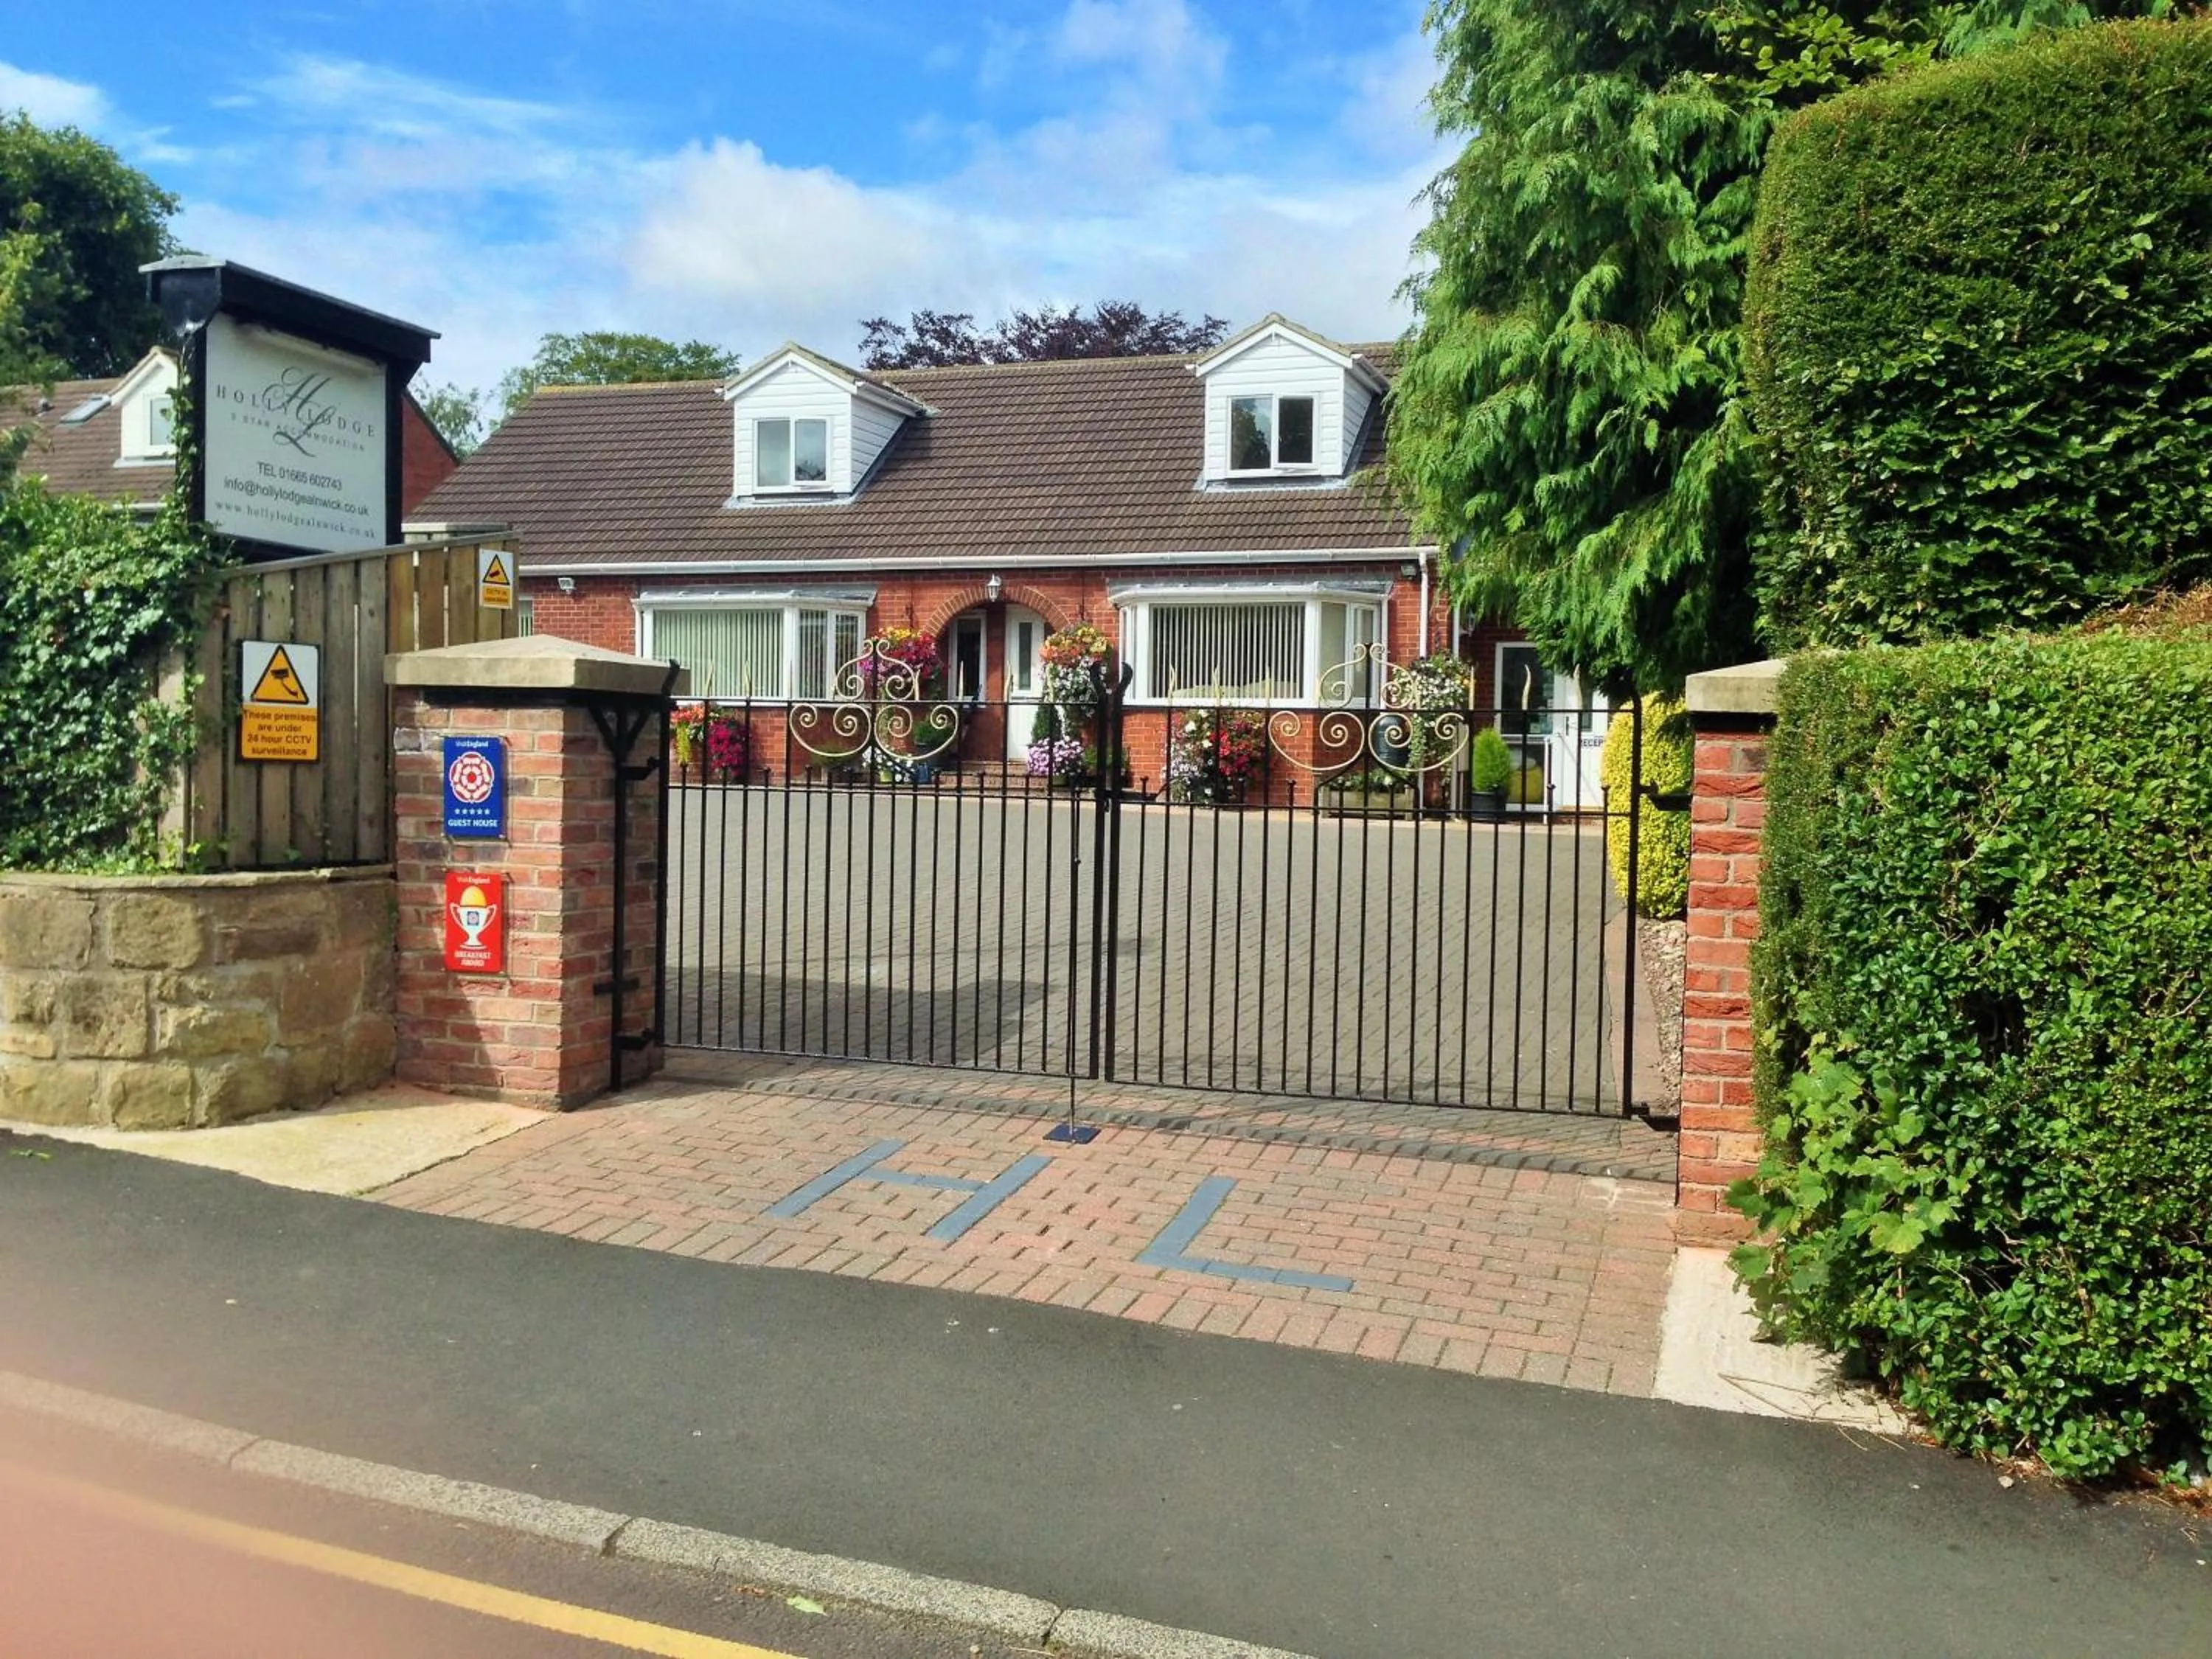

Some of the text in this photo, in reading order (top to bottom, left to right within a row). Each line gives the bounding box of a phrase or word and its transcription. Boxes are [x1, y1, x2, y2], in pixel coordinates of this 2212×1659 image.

[216, 383, 377, 438] HOLLY LODGE
[257, 461, 276, 479] TEL
[309, 473, 343, 492] 602743
[243, 709, 317, 723] These premises
[258, 724, 302, 732] are under
[247, 734, 312, 744] 24 hour CCTV
[251, 746, 307, 756] surveillance
[448, 818, 498, 828] GUEST HOUSE
